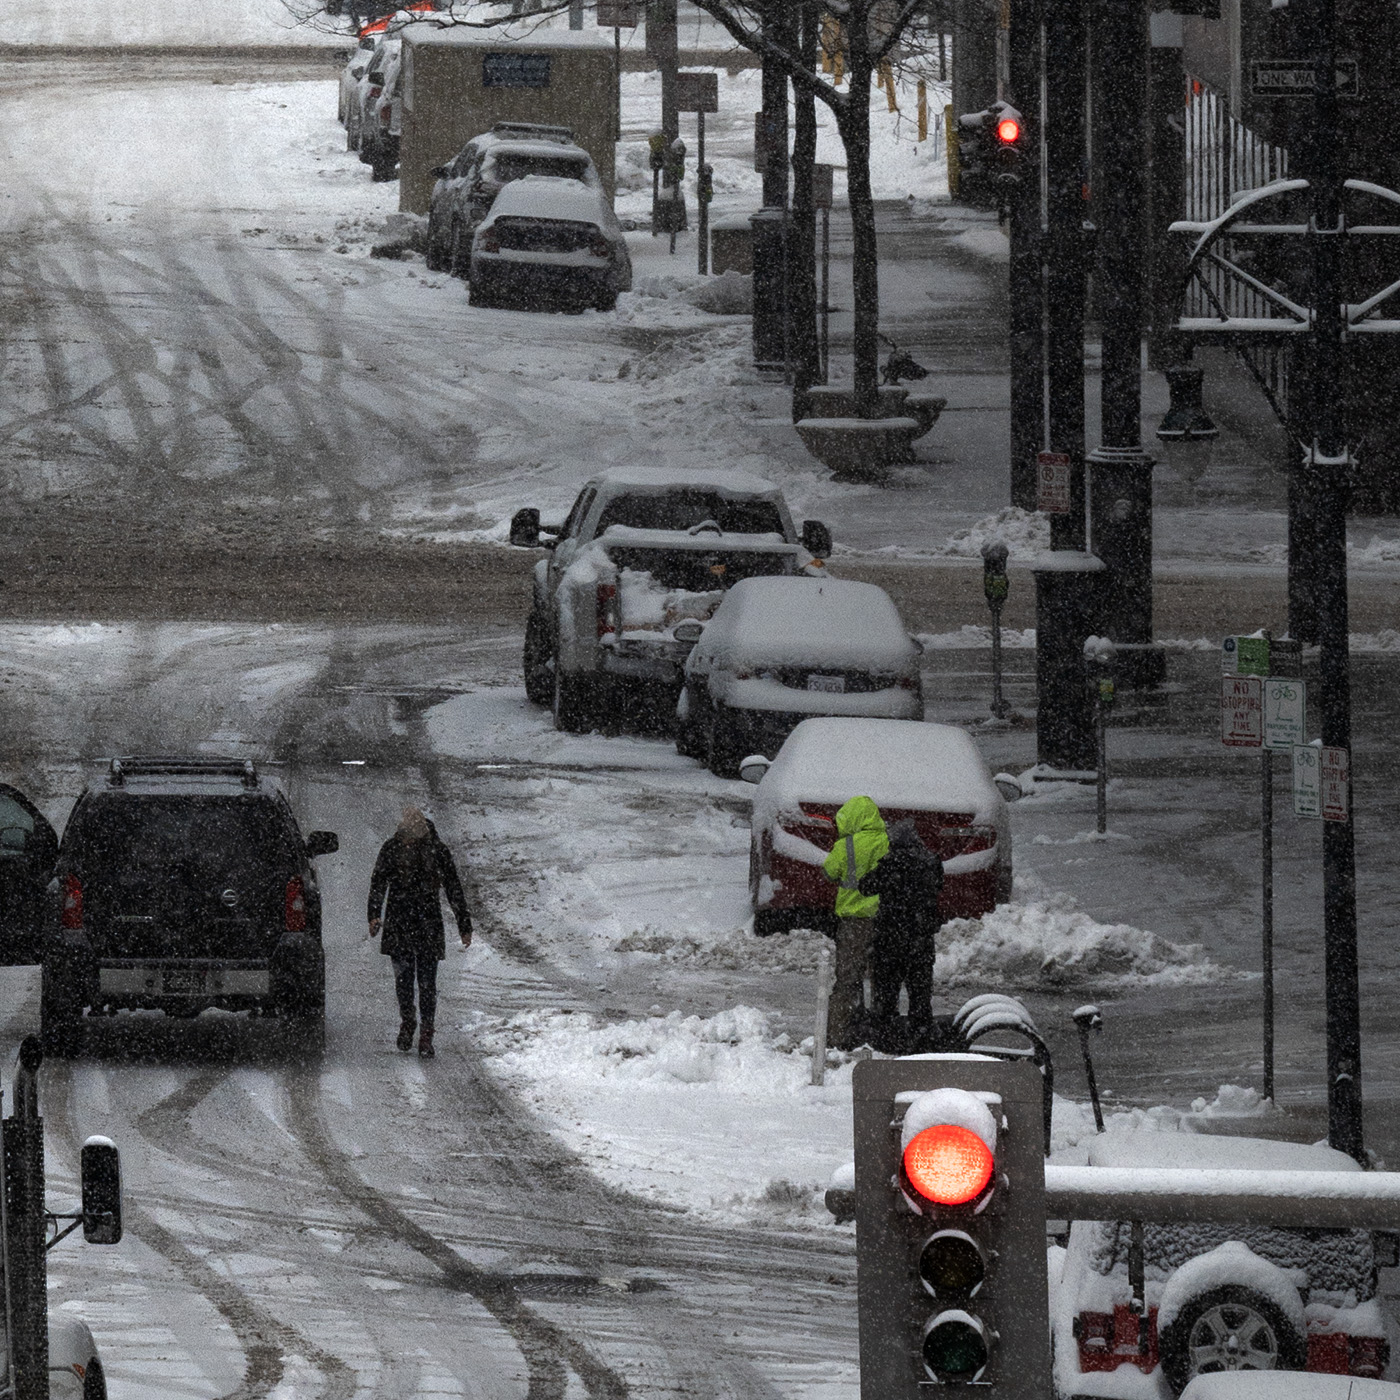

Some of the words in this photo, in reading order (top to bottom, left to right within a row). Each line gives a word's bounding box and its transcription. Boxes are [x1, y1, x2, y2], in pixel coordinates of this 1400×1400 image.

[1261, 71, 1288, 86] ONE
[1294, 71, 1315, 86] WA
[1233, 682, 1250, 694] NO
[1233, 711, 1249, 720] ANY
[1233, 721, 1250, 731] TIME
